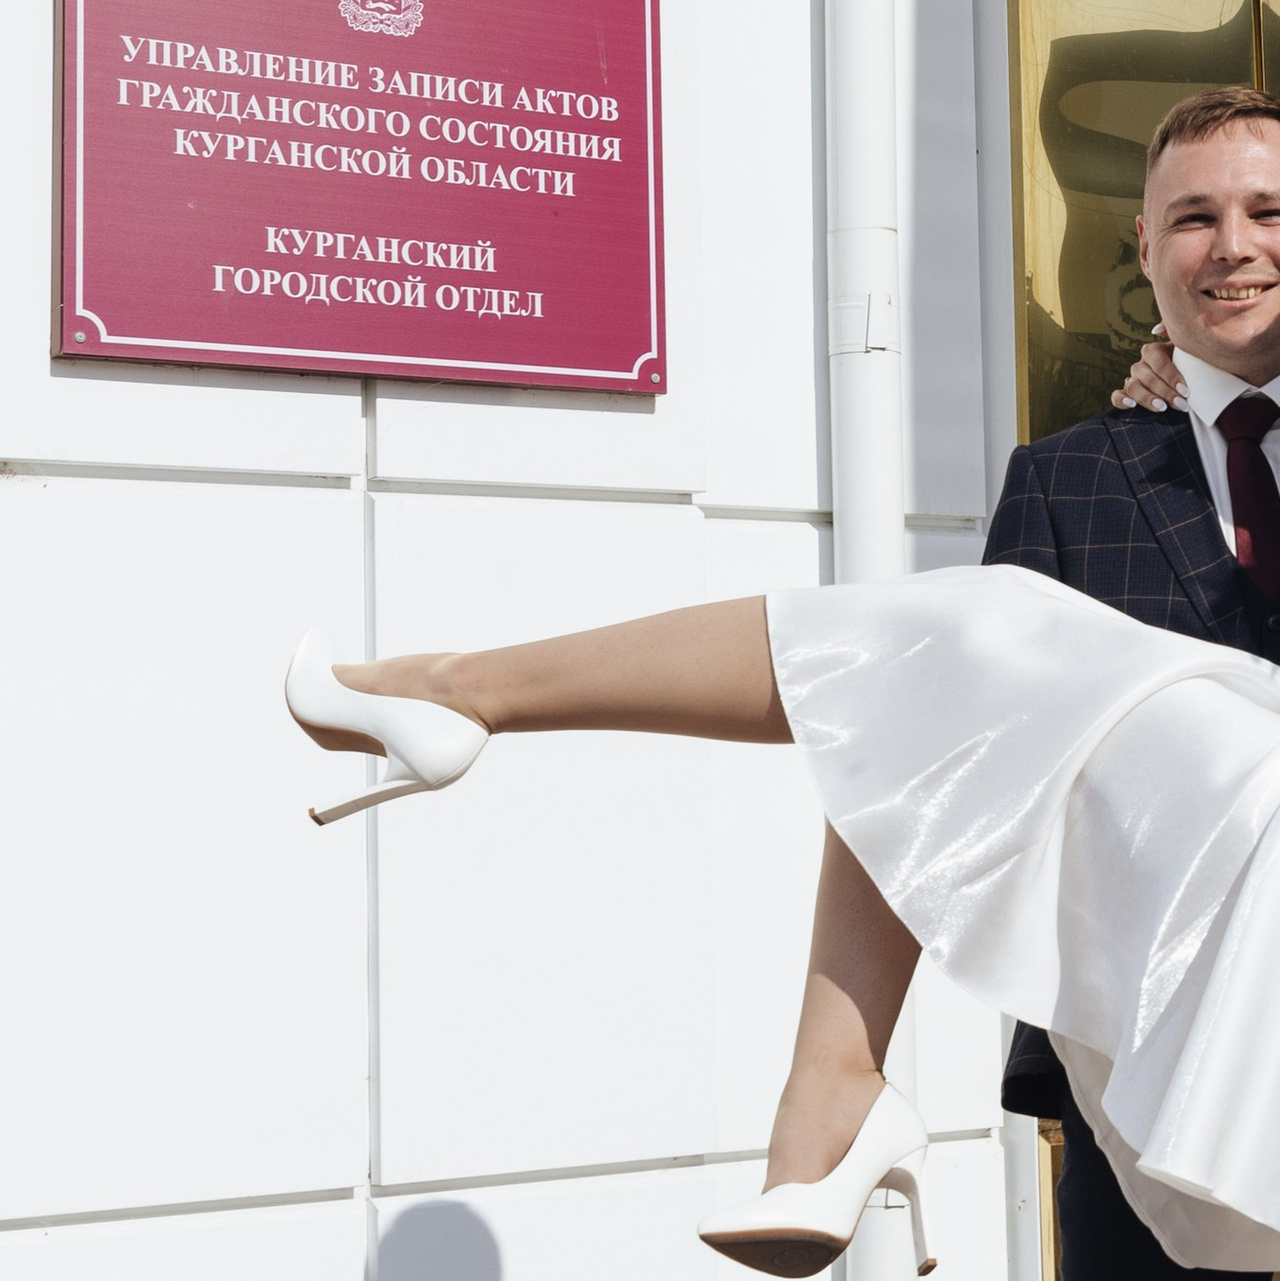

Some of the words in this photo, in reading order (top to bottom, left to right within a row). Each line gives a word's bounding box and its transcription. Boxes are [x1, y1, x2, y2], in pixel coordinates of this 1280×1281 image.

[120, 35, 359, 90] УПРАВЛЕНИЕ
[368, 67, 504, 107] ЗАПИСИ
[513, 87, 619, 122] АКТОВ
[117, 79, 410, 137] ГРАЖДАНСКОГО
[419, 115, 621, 161] СОСТОЯНИЯ
[174, 129, 411, 179] КУРГАНСКОЙ
[421, 157, 575, 196] ОБЛАСТИ
[265, 227, 496, 272] КУРГАНСКИЙ
[213, 265, 427, 307] ГОРОДСКОЙ
[435, 285, 545, 319] ОТДЕЛ
